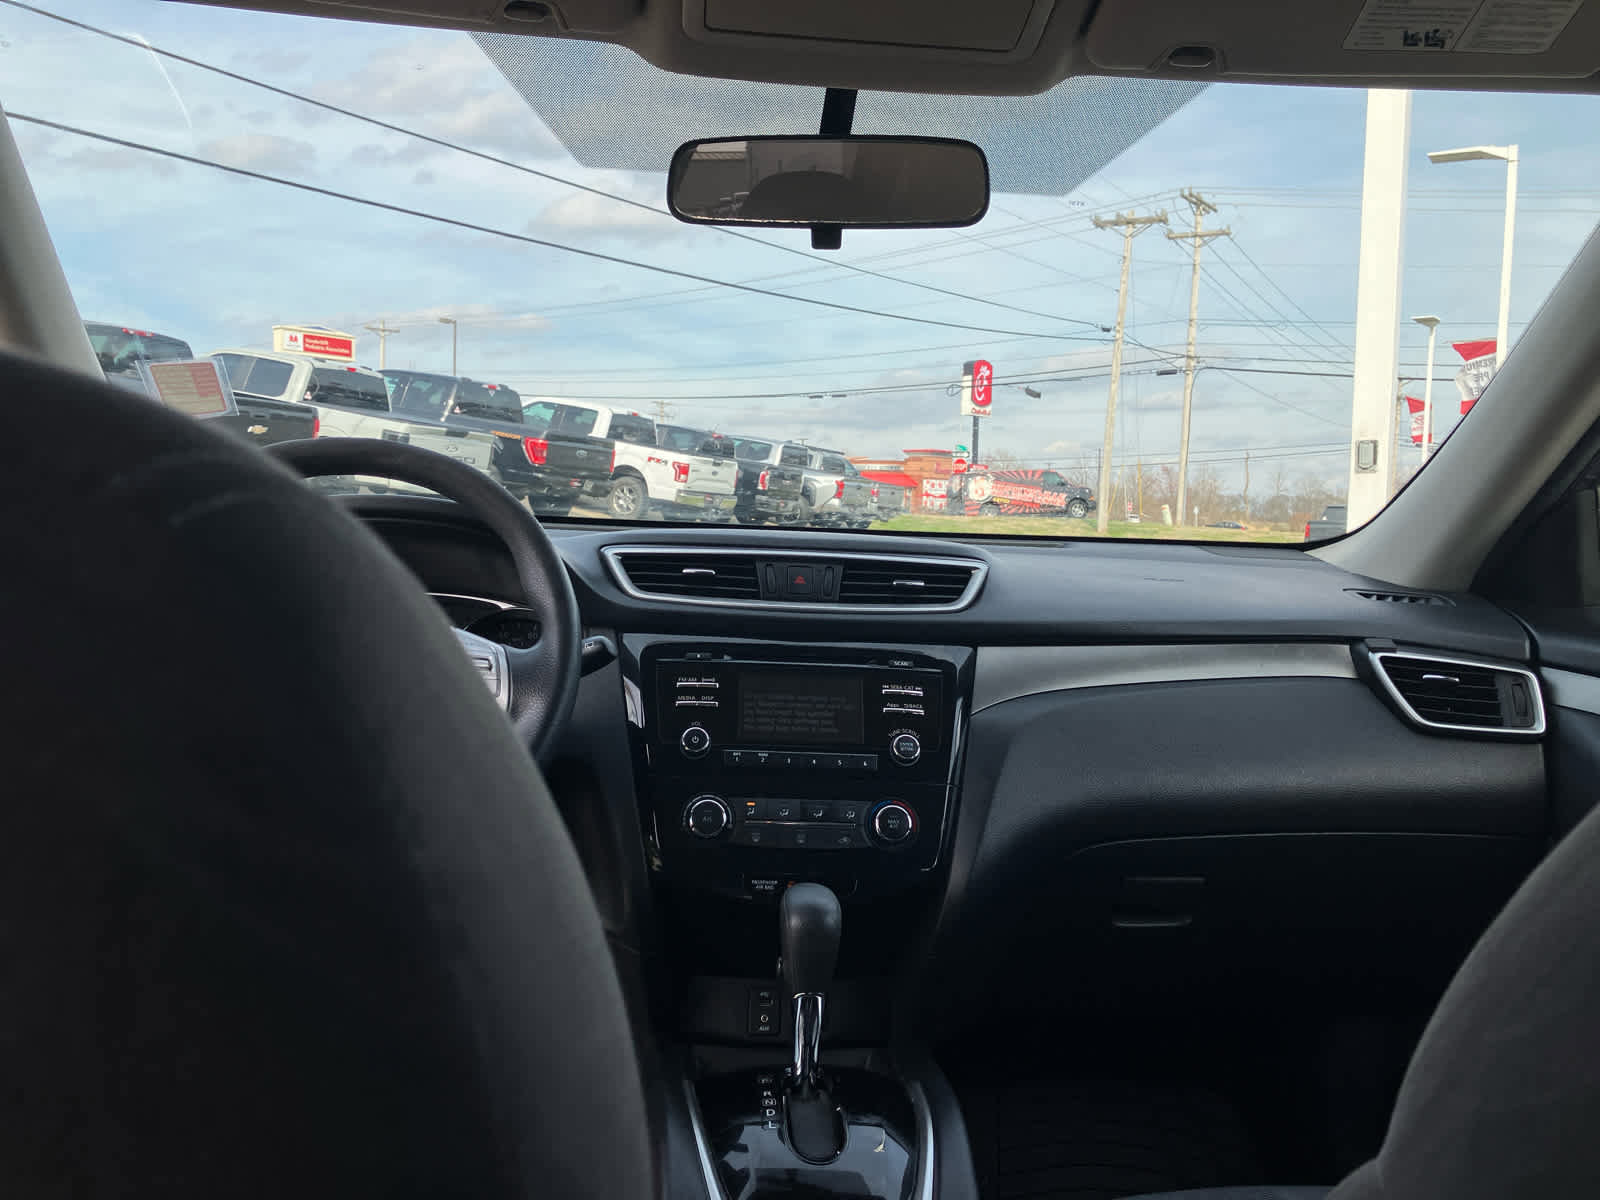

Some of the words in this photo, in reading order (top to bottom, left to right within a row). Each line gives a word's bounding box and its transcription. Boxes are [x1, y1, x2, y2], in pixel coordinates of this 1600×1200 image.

[953, 463, 968, 471] STOP
[766, 1108, 776, 1117] D
[768, 1120, 777, 1129] L
